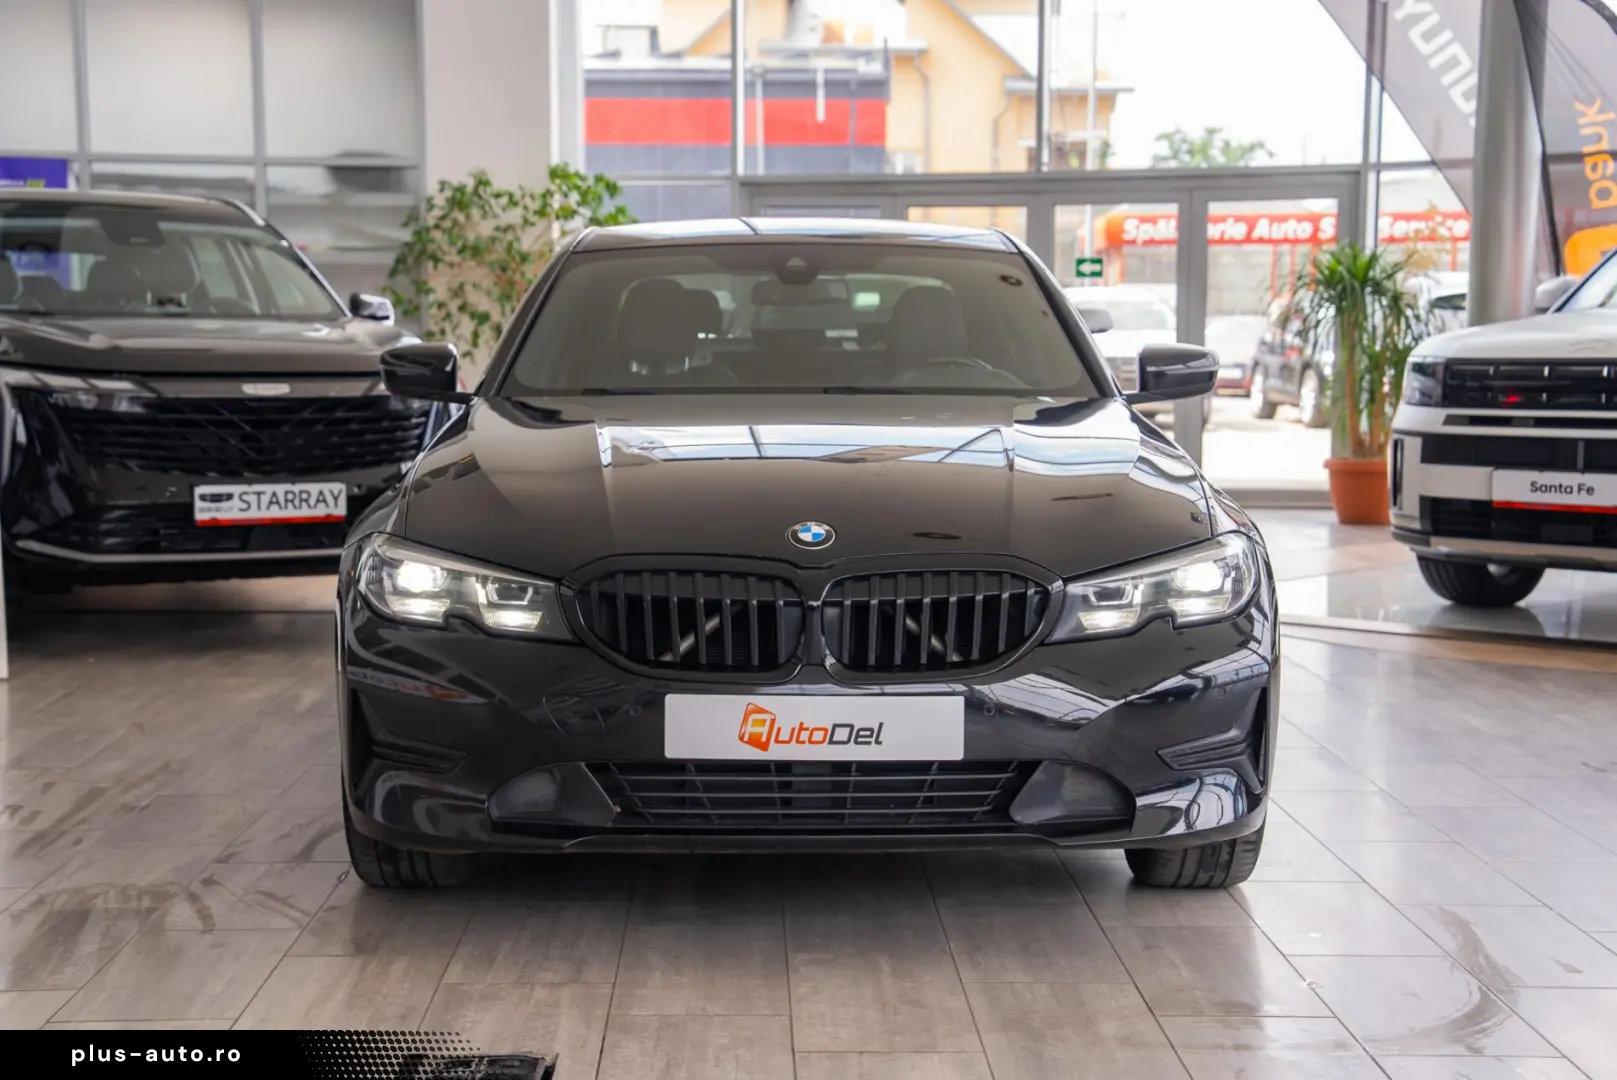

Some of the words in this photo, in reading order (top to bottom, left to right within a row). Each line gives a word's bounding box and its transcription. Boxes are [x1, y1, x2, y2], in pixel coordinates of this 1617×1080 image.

[1251, 217, 1314, 240] Auto
[1530, 481, 1574, 495] Santa
[1577, 483, 1595, 496] Fe
[238, 489, 343, 512] STARRAY
[742, 709, 884, 747] AutoDel
